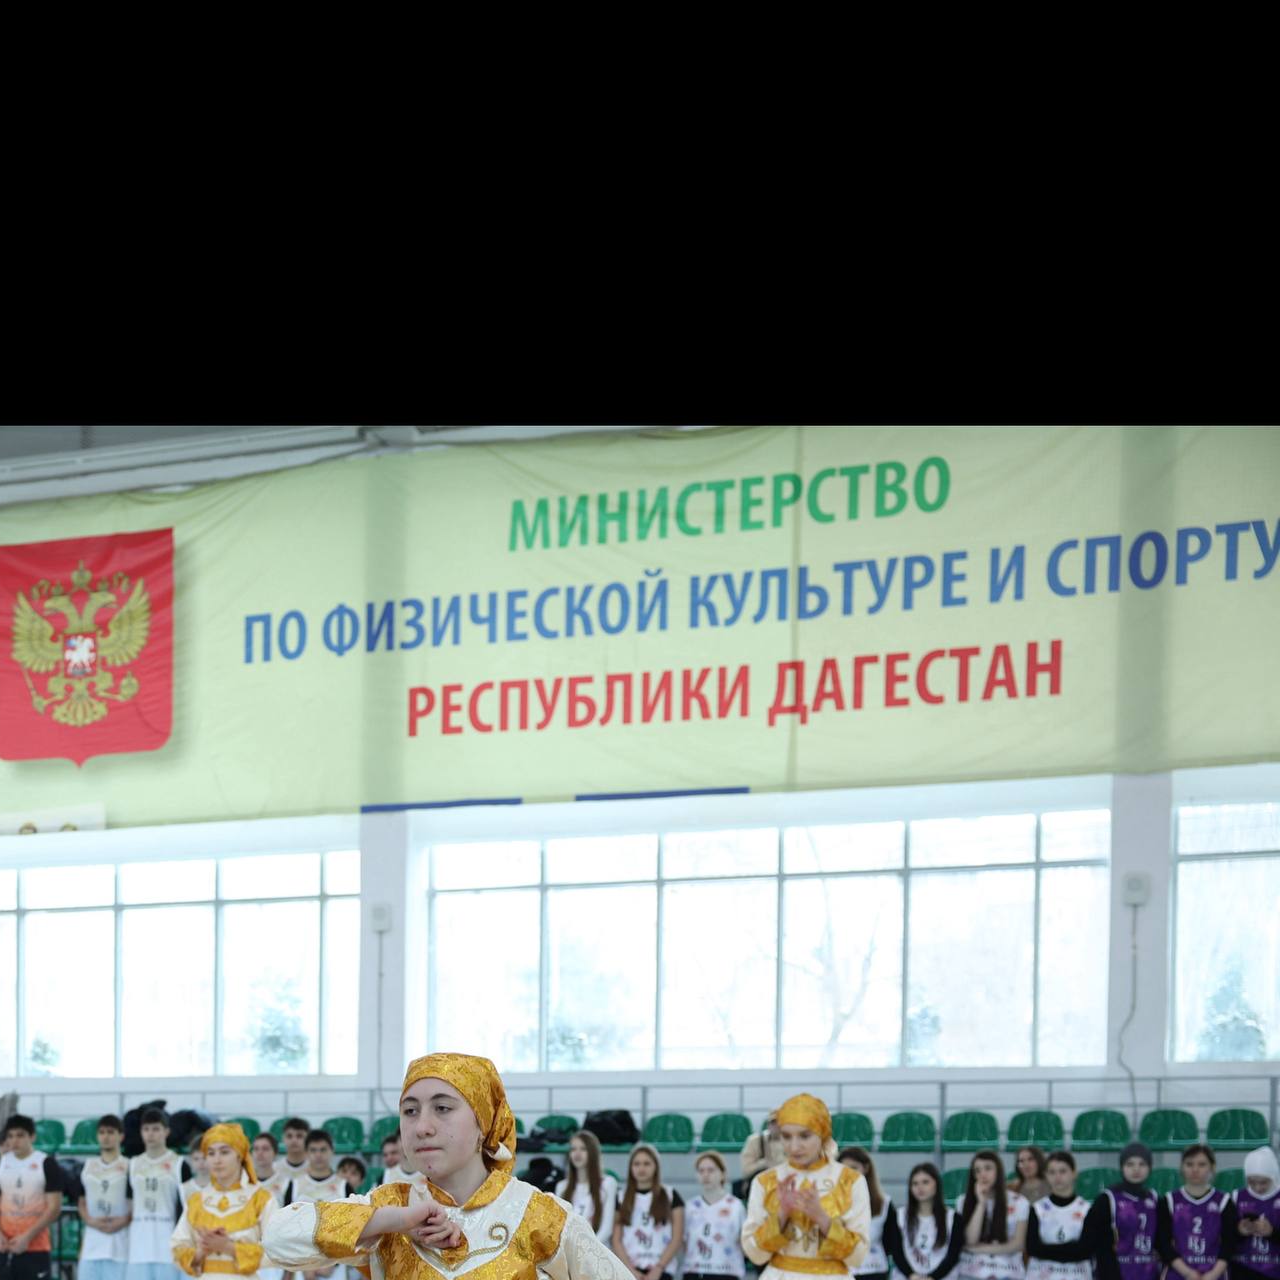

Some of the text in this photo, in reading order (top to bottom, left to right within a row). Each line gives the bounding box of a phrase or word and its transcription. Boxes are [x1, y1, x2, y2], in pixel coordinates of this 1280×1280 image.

[508, 456, 952, 554] МИНИСТЕРСТВО
[243, 517, 1280, 665] ПО ФИЗИЧЕСКОЙ КУЛЬТУРЕ И СПОРТУ
[407, 639, 1064, 738] РЕСПУБЛИКИ ДАГЕСТАН
[1192, 1216, 1203, 1235] 2
